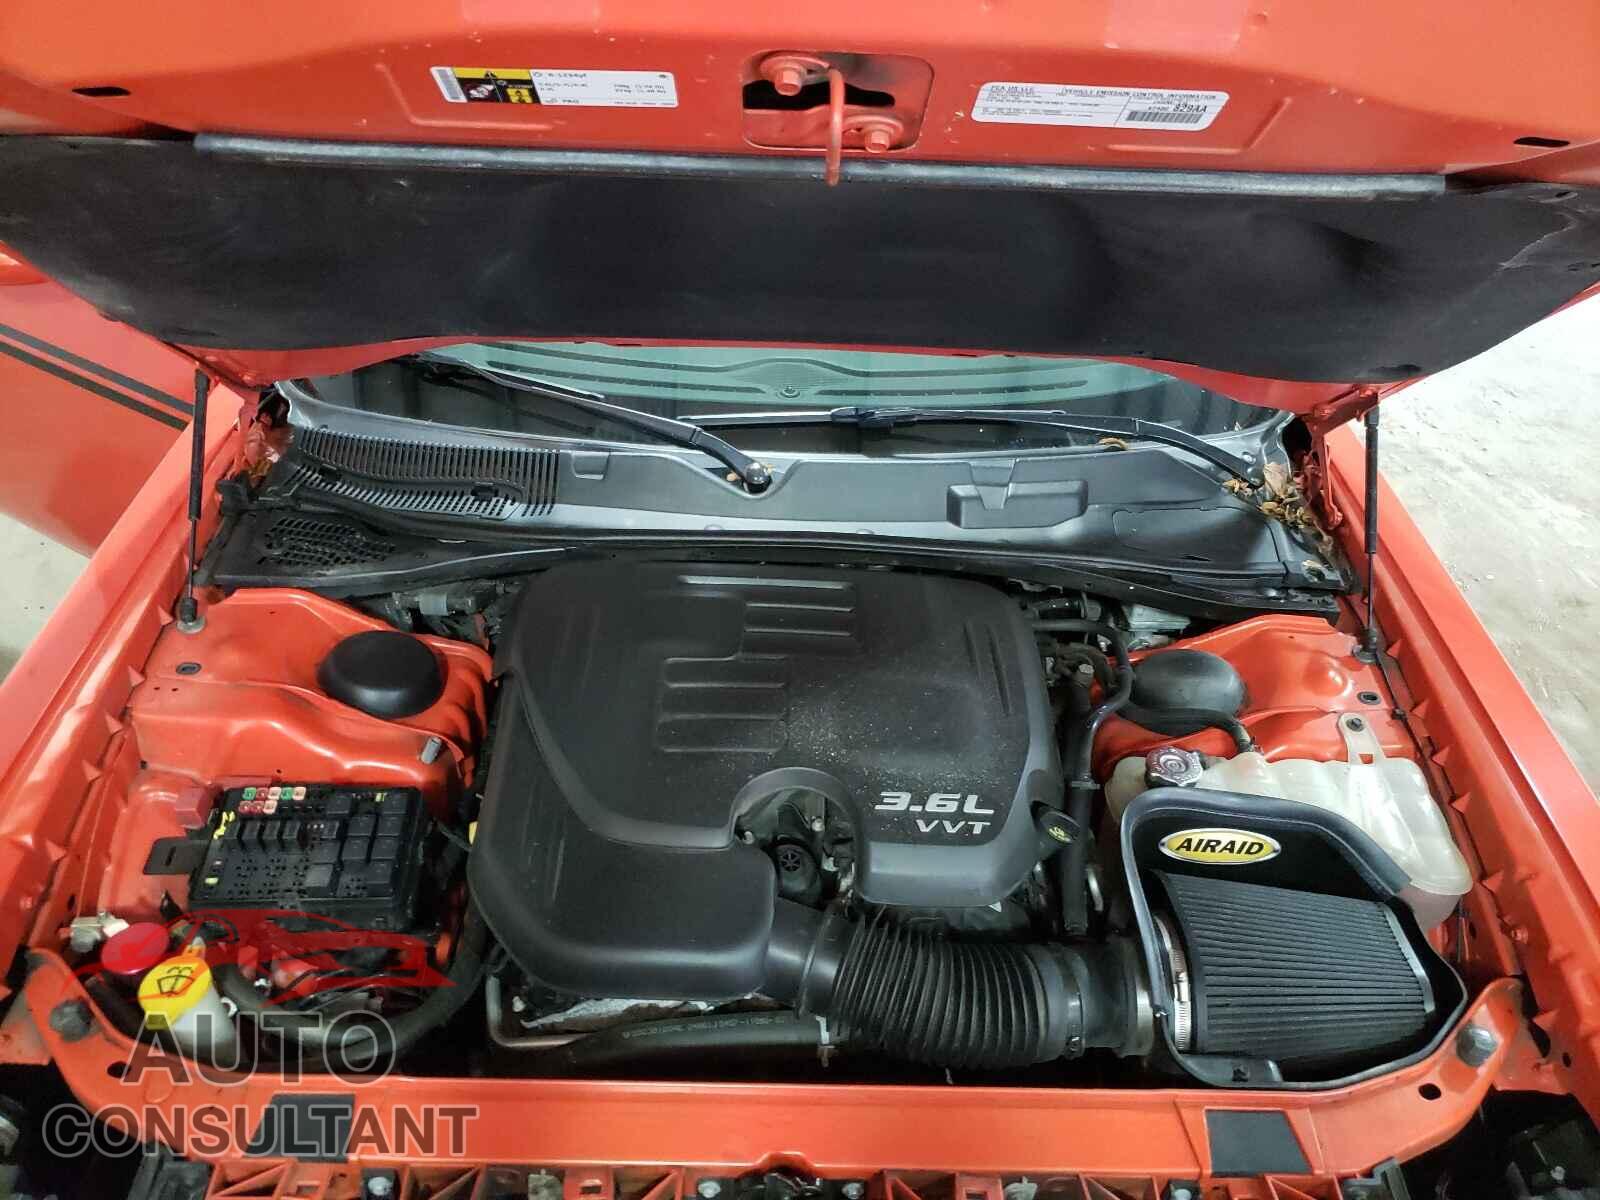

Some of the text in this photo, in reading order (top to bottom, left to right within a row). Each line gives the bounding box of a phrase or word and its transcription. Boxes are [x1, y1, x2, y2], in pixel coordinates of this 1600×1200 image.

[1096, 89, 1130, 97] EMISSION
[1173, 103, 1208, 113] 829AA
[874, 791, 995, 814] 3.6L
[915, 819, 991, 834] VVT
[1174, 837, 1264, 855] AIRAID
